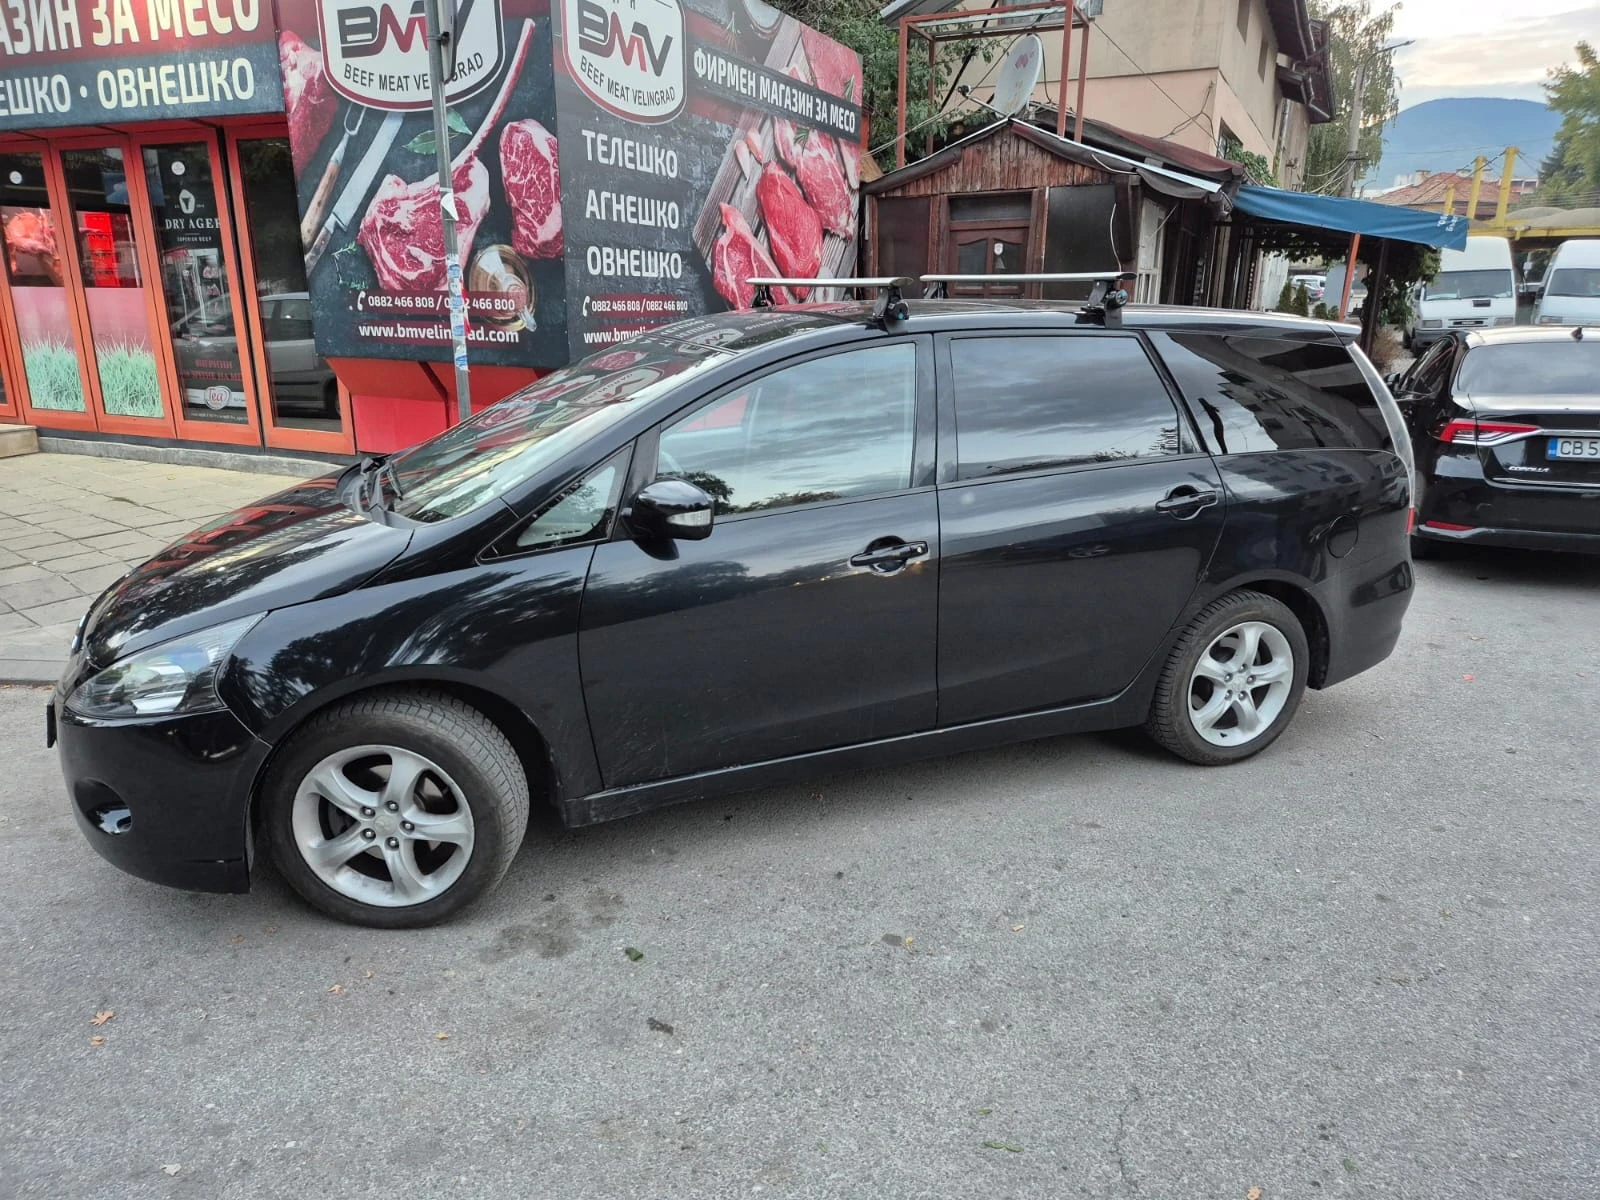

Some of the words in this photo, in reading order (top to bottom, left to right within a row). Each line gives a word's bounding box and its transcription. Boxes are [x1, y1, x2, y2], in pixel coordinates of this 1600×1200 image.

[92, 0, 140, 46] ЗА
[147, 0, 259, 41] МЕСО
[578, 0, 674, 77] BMV
[97, 57, 255, 110] ОВНЕШКО
[344, 63, 375, 88] BEEF
[378, 73, 410, 92] MEAT
[415, 52, 484, 91] VERAD
[580, 55, 605, 88] BEEF
[607, 77, 631, 103] MEAT
[632, 86, 676, 107] VELINGRAD
[693, 47, 756, 98] ФИРМЕН
[759, 75, 813, 118] МАГАЗИН
[815, 97, 828, 124] ЗА
[830, 103, 856, 134] МЕСО
[582, 129, 678, 179] ТЕЛЕШКО
[165, 218, 185, 229] DRY
[585, 189, 680, 230] АГНЕШКО
[586, 245, 682, 280] ОВНЕШКО
[368, 295, 393, 307] 0882
[394, 296, 413, 308] 466
[415, 297, 435, 308] 808
[444, 297, 471, 309] 02
[472, 298, 492, 309] 466
[494, 299, 516, 311] 800
[591, 300, 611, 312] 0882
[612, 300, 626, 311] 466
[627, 300, 640, 311] 808
[646, 300, 663, 311] 0882
[663, 301, 676, 311] 466
[676, 301, 688, 311] 800
[359, 323, 519, 343] www.bmvelinad.com
[1560, 440, 1583, 456] CB
[1588, 441, 1599, 456] 5
